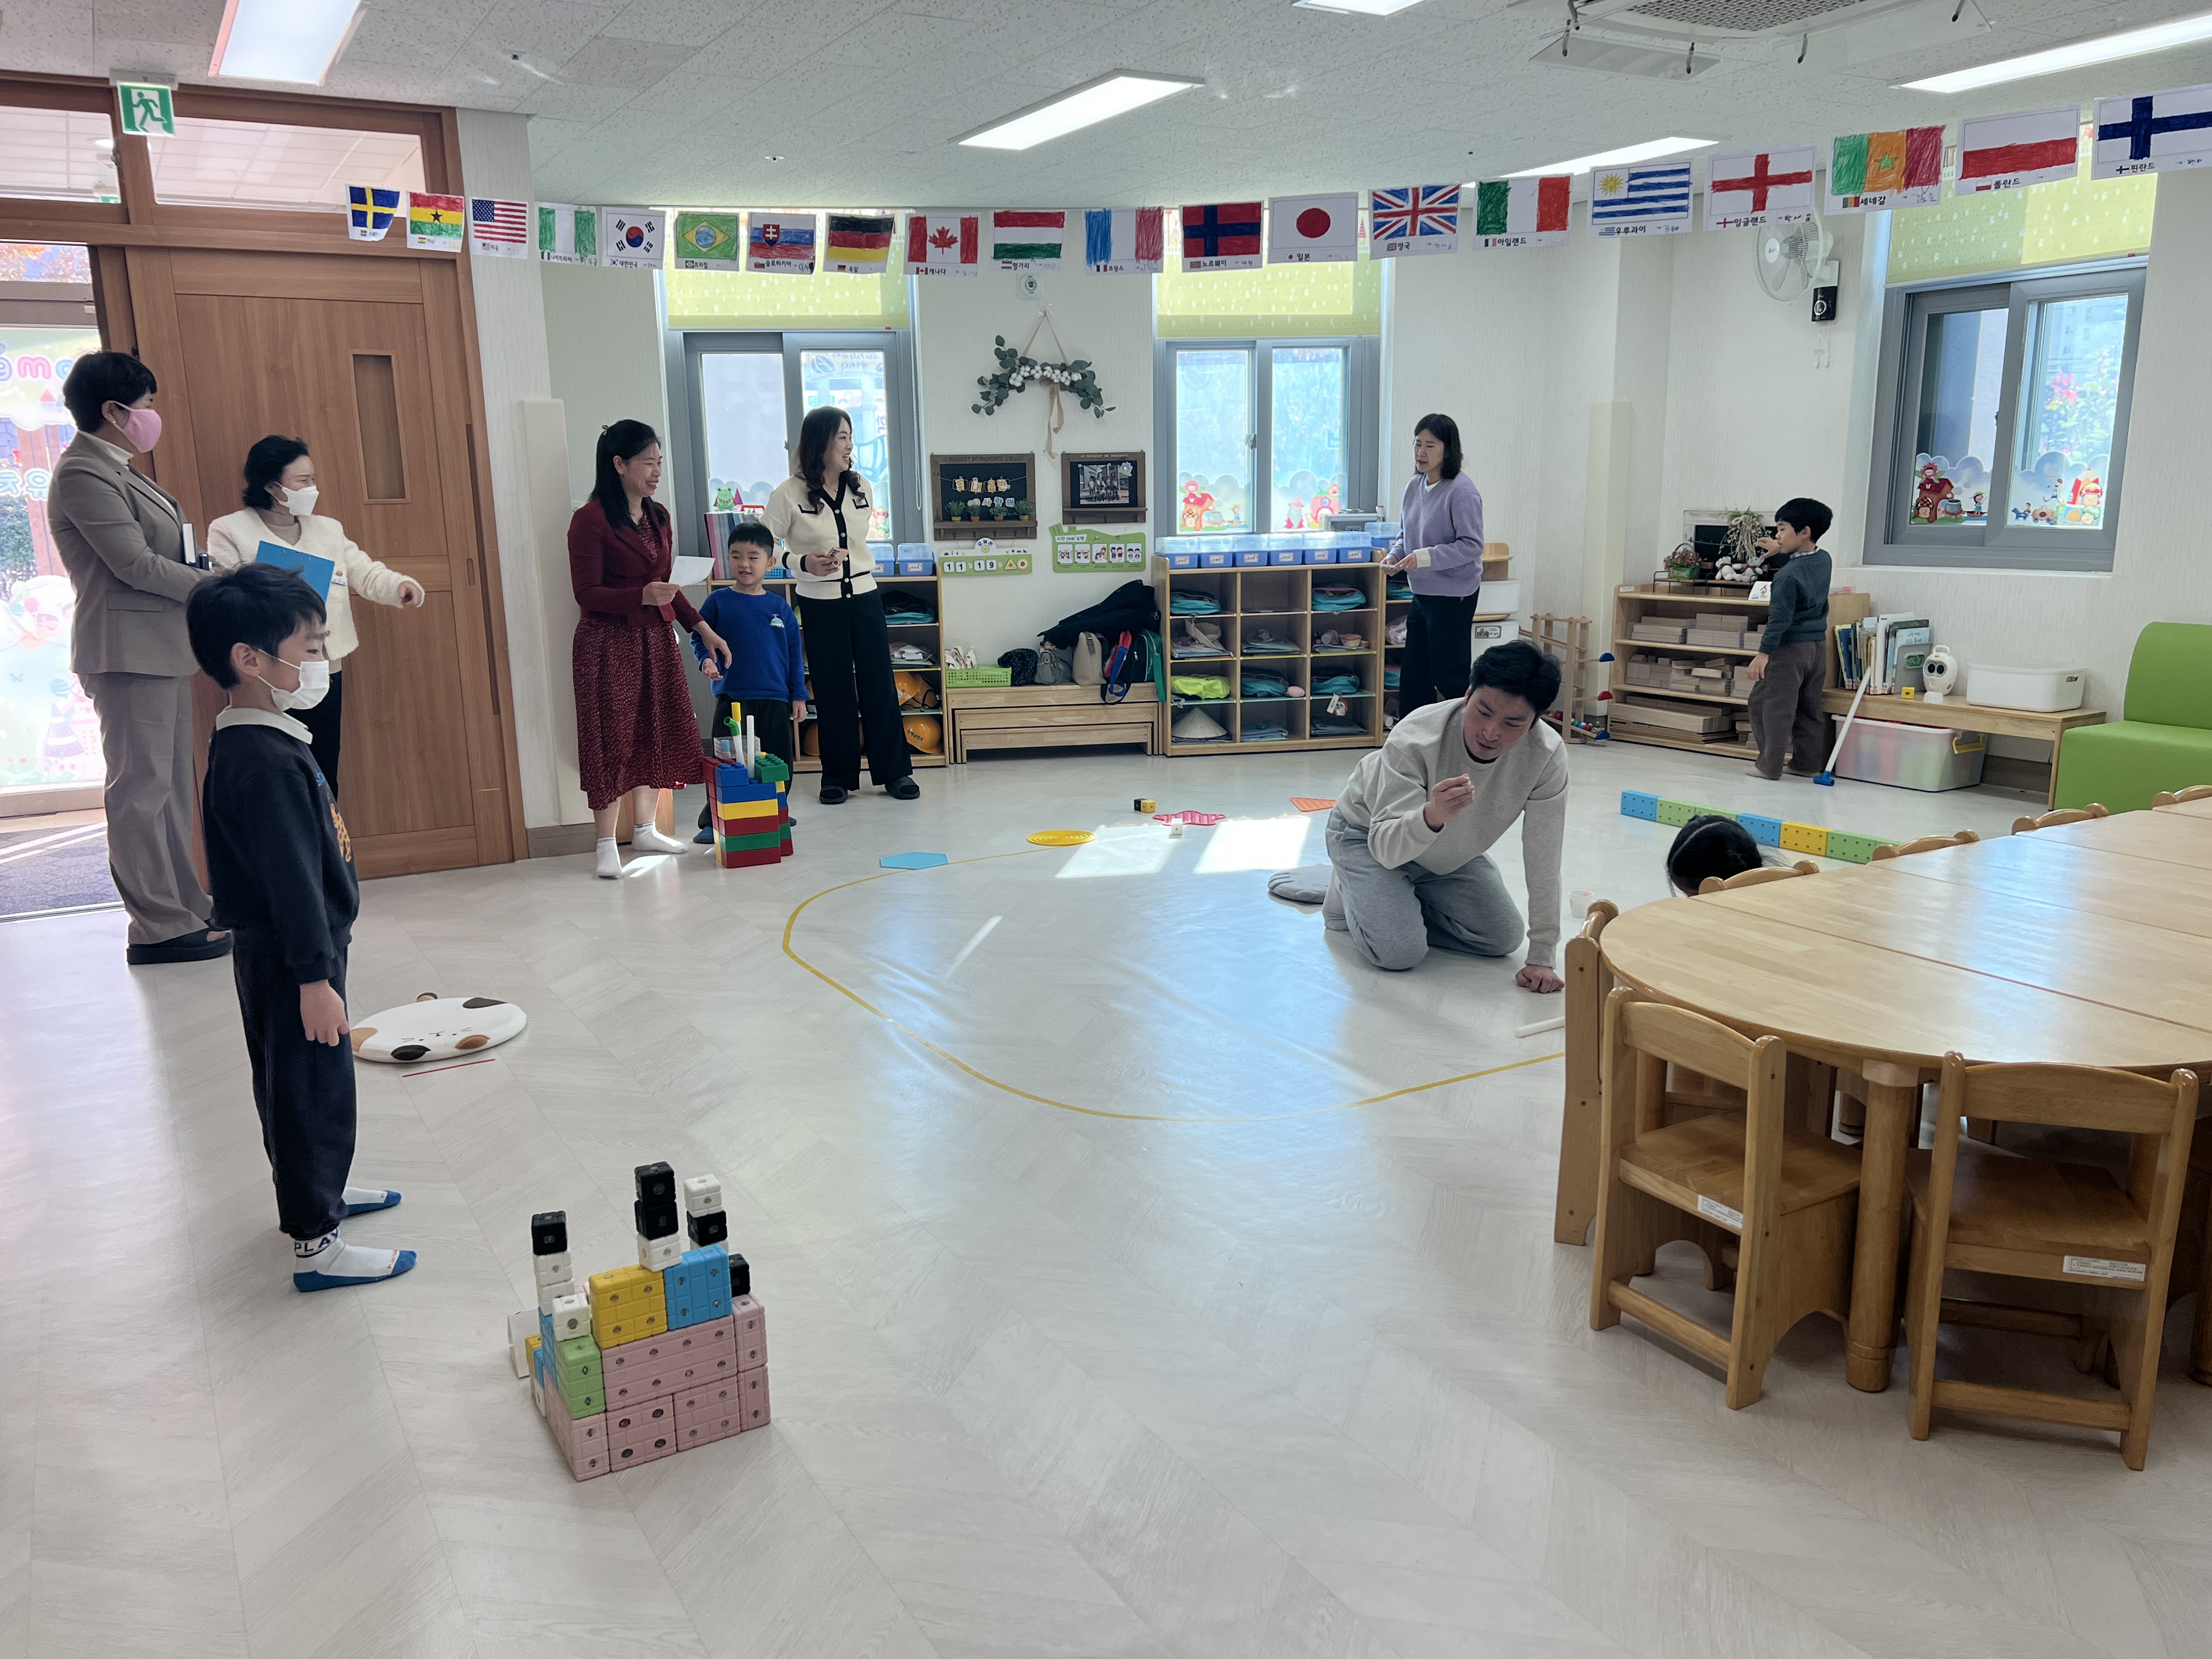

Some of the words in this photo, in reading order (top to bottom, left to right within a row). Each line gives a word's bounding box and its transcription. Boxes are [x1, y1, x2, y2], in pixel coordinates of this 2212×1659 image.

[2131, 162, 2155, 173] 핀란드
[1993, 177, 2021, 190] 폴란드
[1860, 196, 1886, 206] 세네갈
[1734, 216, 1767, 227] 잉글랜드
[1616, 225, 1646, 234] 우루과이
[1397, 242, 1410, 251] 영국
[1497, 238, 1527, 246] 아일랜드
[551, 253, 572, 263] 나이지리아
[1297, 252, 1311, 261] 일본
[929, 267, 946, 275] 캐나다
[841, 360, 868, 370] park
